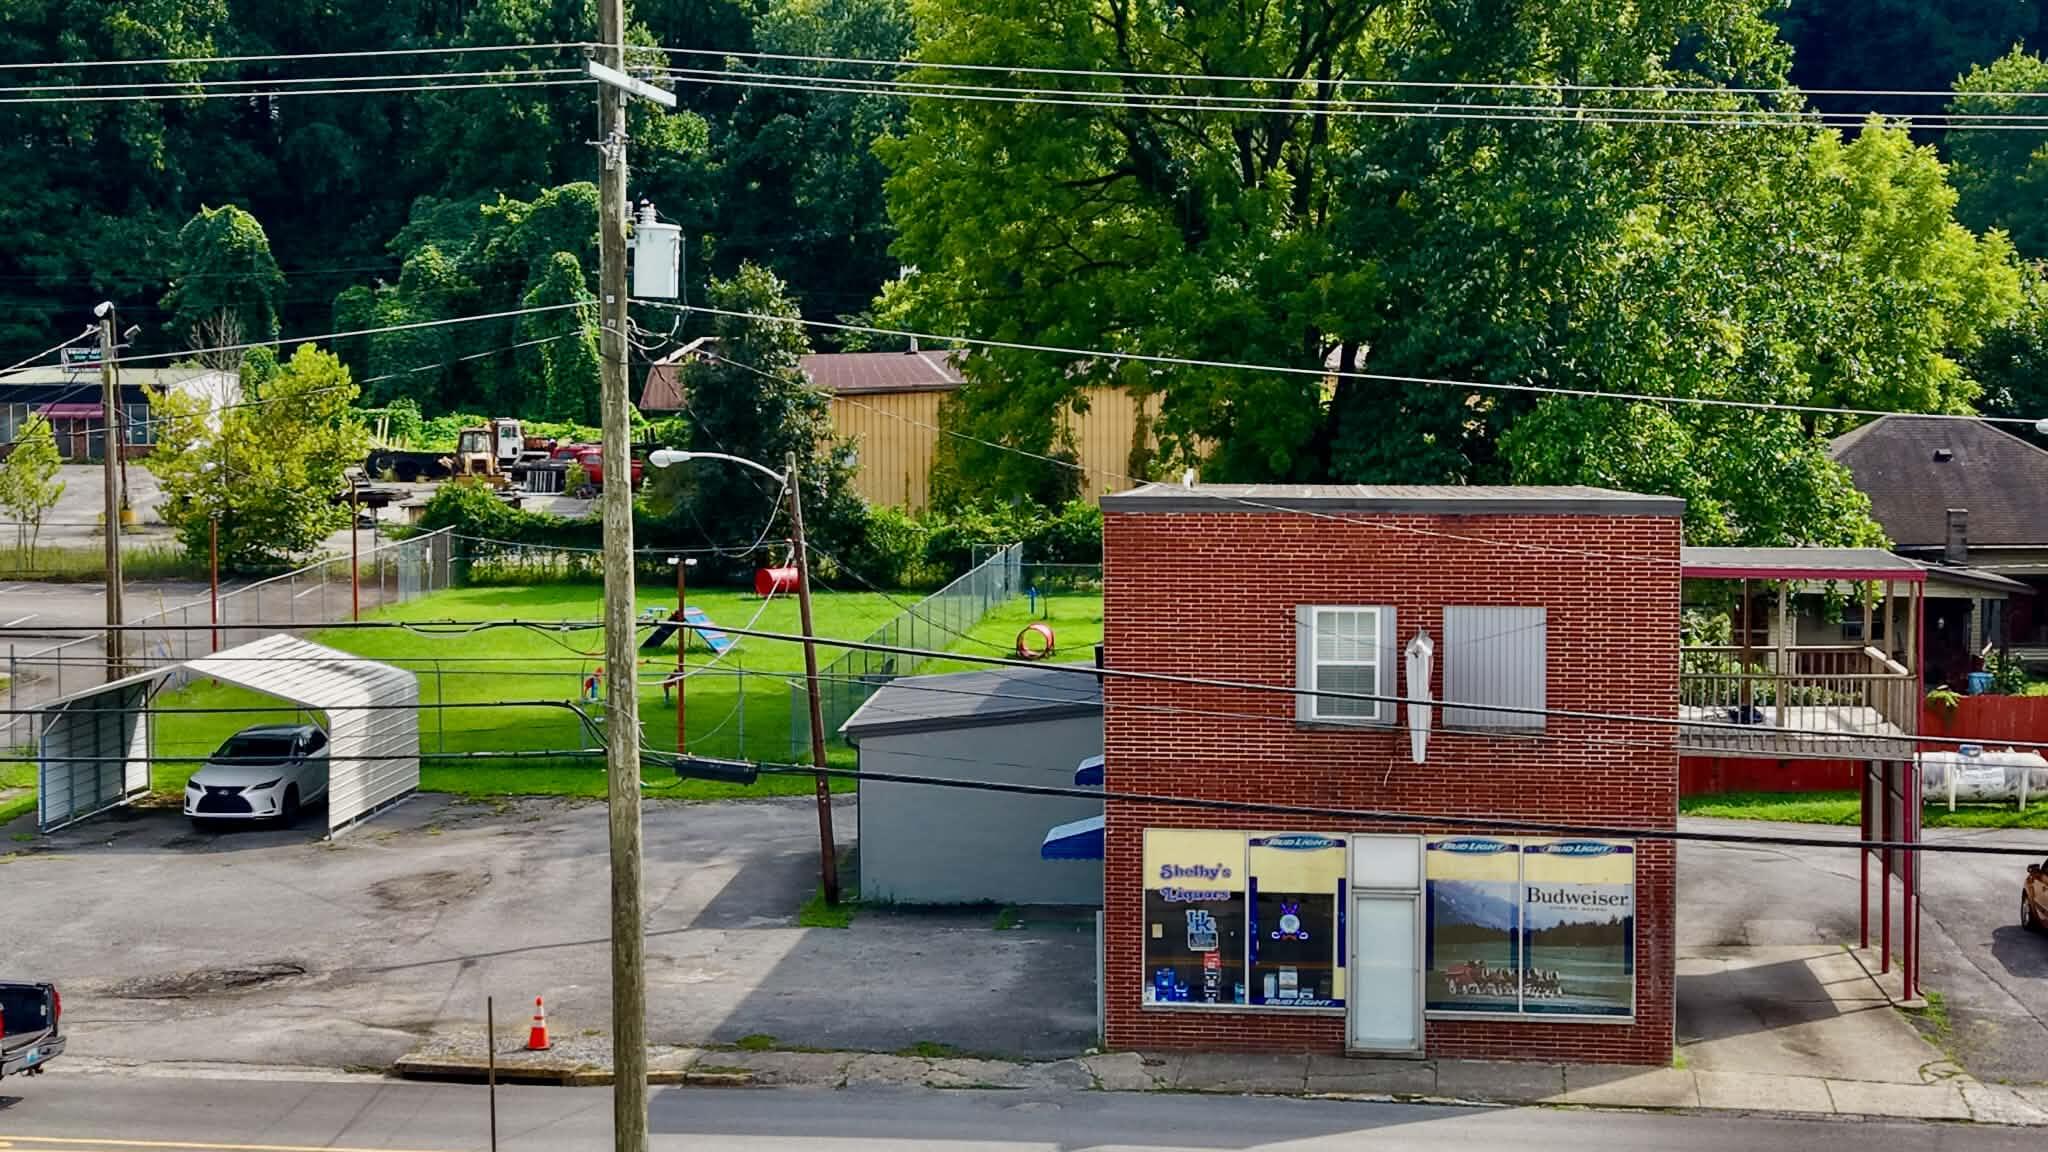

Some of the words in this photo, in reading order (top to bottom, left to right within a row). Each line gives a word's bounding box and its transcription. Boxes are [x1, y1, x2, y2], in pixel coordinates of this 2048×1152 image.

[1160, 863, 1232, 882] Shelby's
[1160, 886, 1231, 903] Liquors
[1527, 887, 1629, 906] Budweiser
